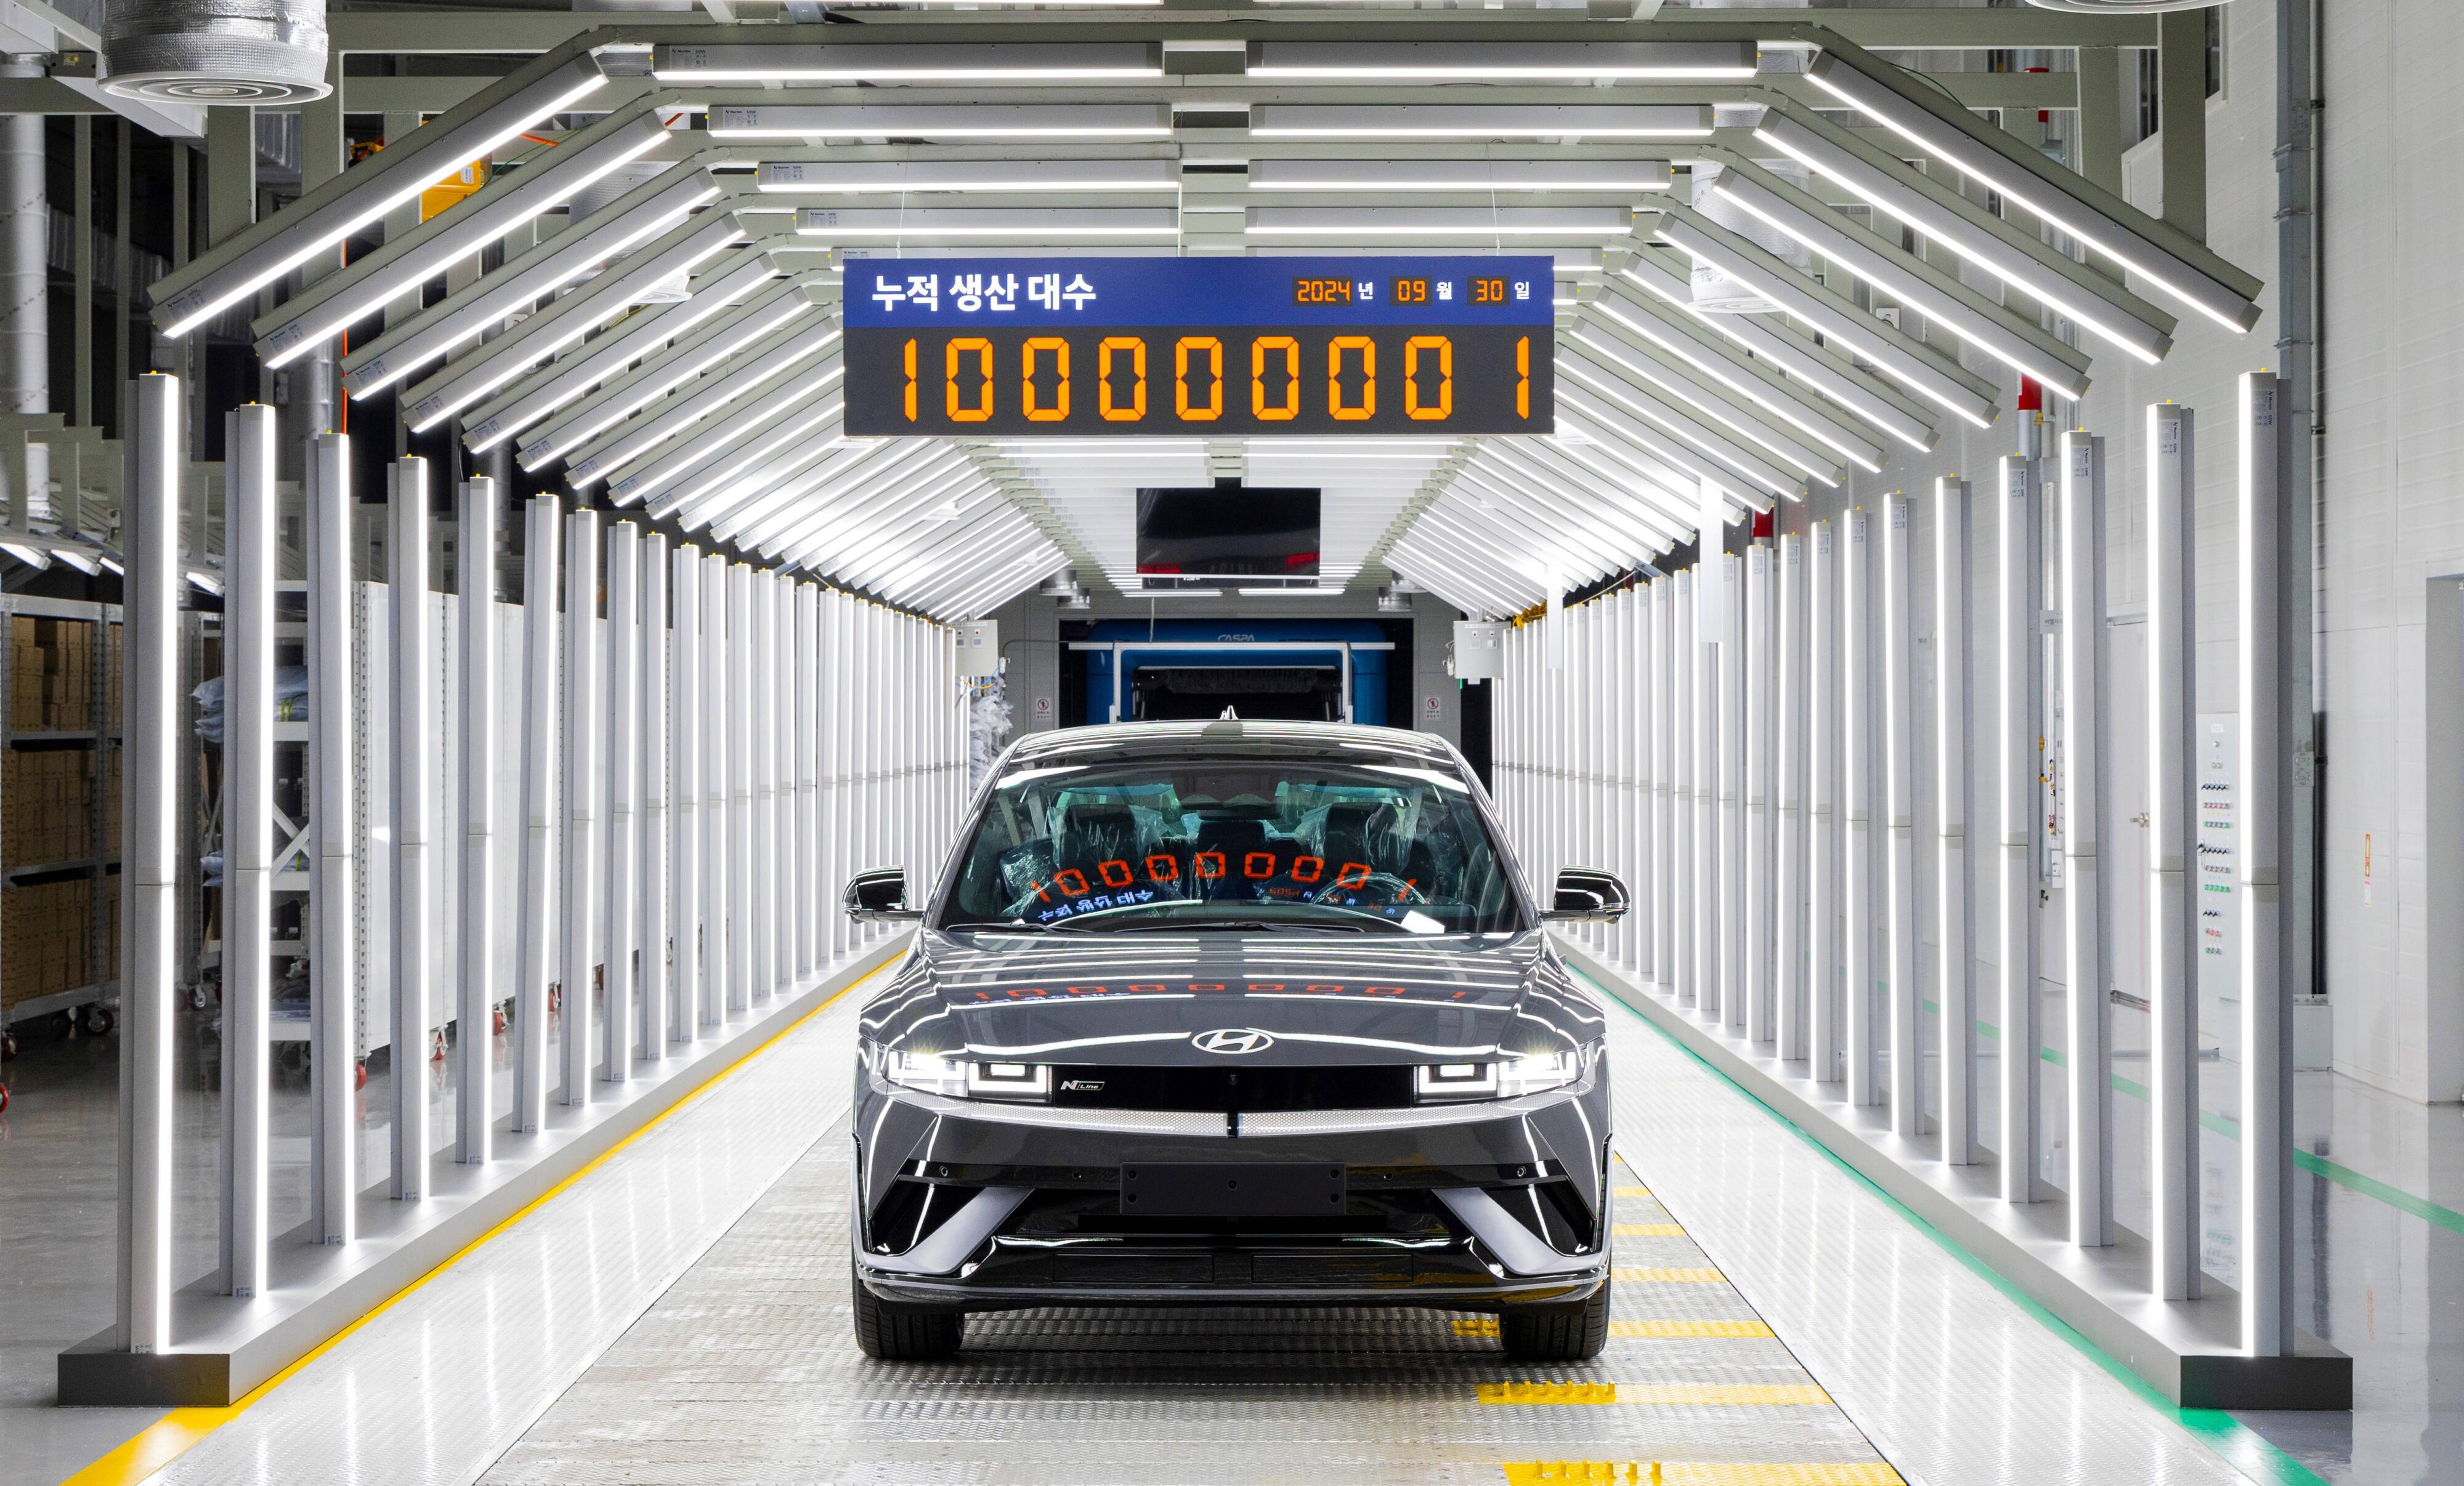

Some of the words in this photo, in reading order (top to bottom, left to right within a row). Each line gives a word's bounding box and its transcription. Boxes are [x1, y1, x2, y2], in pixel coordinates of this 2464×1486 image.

[872, 273, 938, 312] 누적
[949, 273, 1019, 312] 생산
[1027, 273, 1096, 310] 대수
[1297, 280, 1350, 302] 2024
[1358, 281, 1374, 301] 년
[1398, 280, 1426, 302] 09
[1436, 281, 1453, 301] 월
[1476, 280, 1503, 302] 30
[1514, 281, 1530, 301] 일
[1060, 1080, 1079, 1090] N
